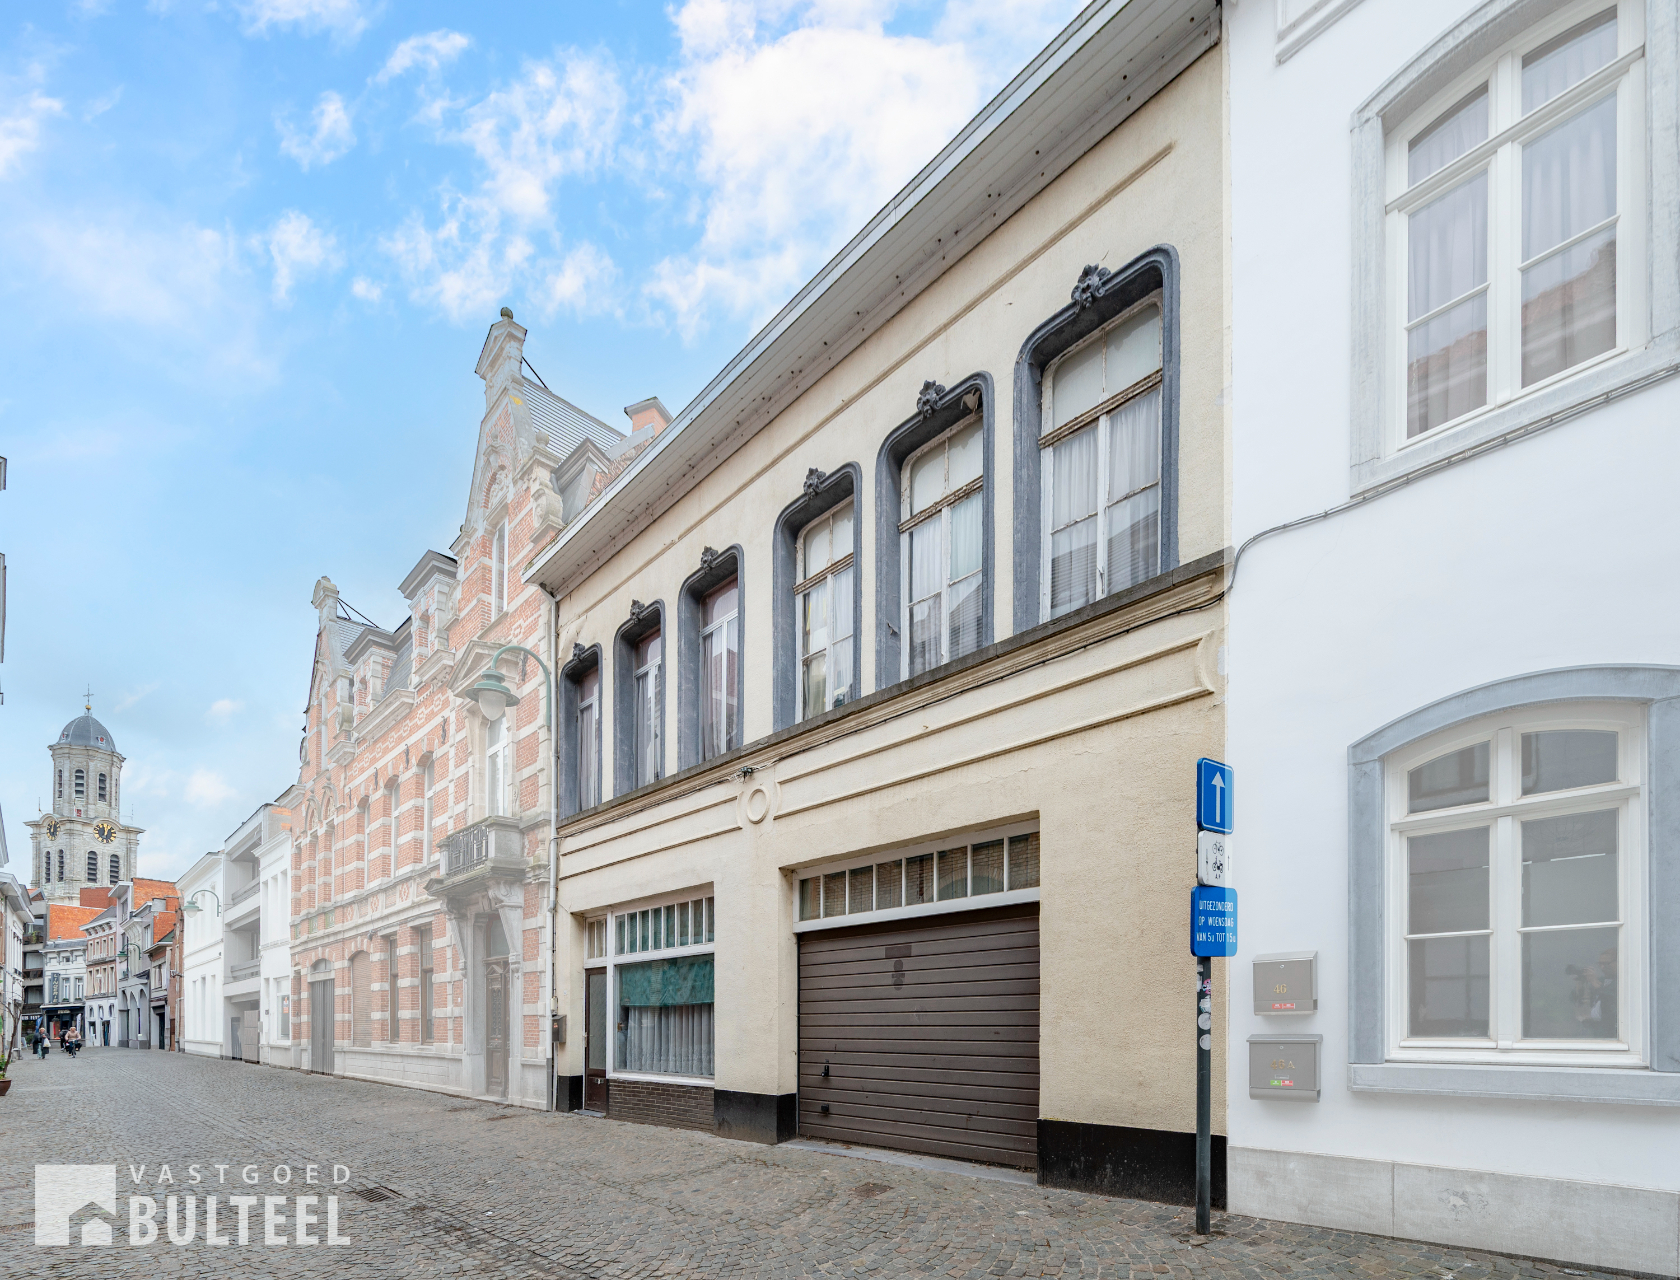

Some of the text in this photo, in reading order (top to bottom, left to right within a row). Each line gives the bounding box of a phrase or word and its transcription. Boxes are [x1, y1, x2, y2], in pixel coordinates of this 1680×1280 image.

[1199, 900, 1234, 912] UITGEZONDERD
[1199, 915, 1234, 928] OP WOENSDAG
[1196, 932, 1207, 942] VAN
[1216, 932, 1226, 943] TOT
[1273, 983, 1287, 994] 46
